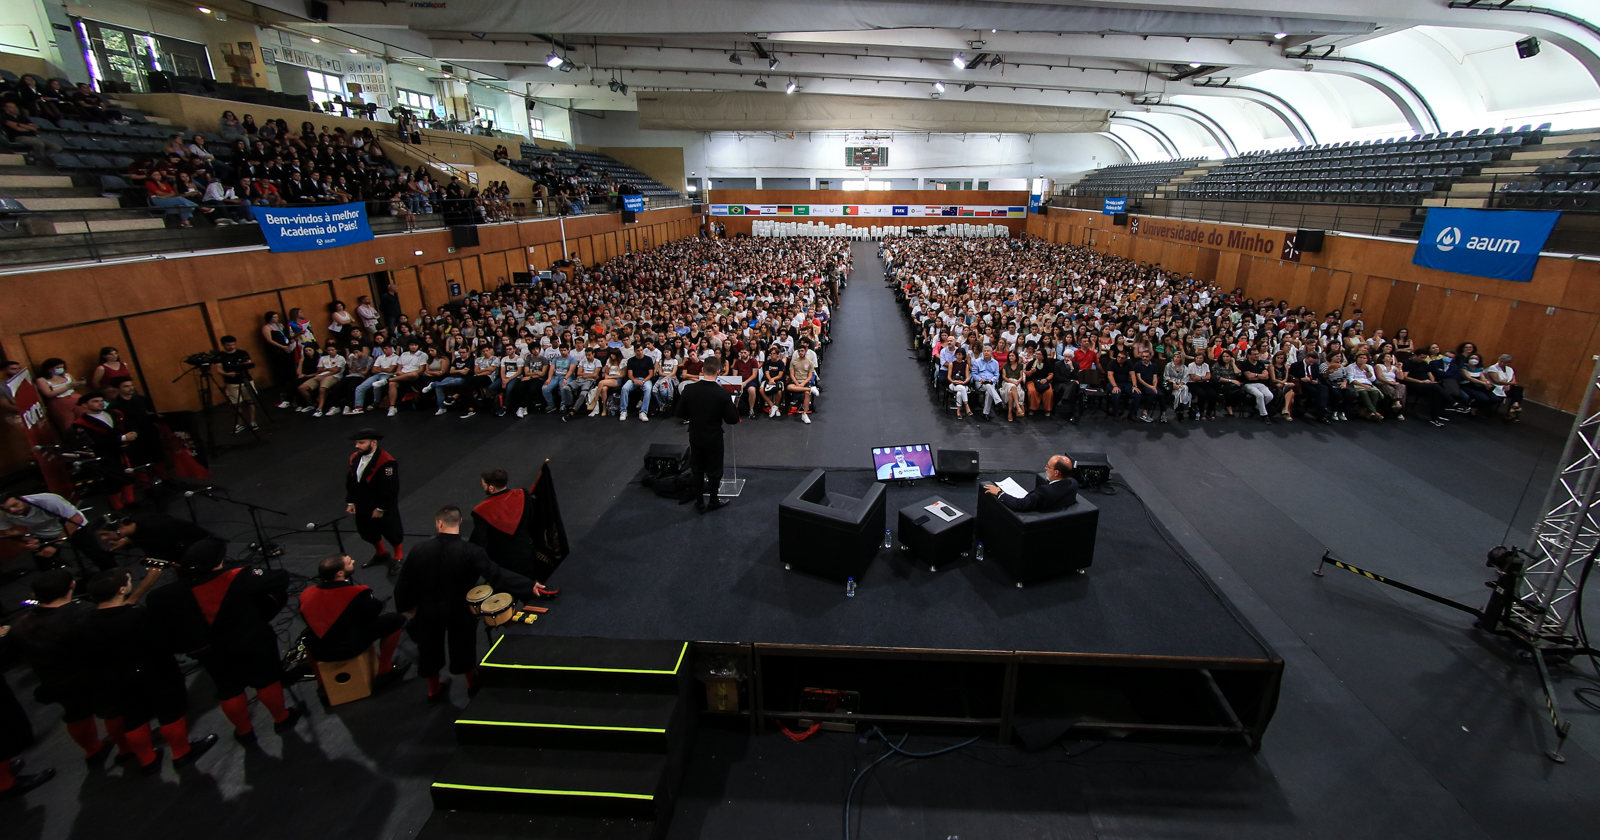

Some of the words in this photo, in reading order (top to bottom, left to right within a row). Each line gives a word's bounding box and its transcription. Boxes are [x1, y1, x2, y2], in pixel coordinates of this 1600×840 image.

[265, 213, 323, 225] Bem-vindos
[325, 212, 331, 222] à
[332, 209, 360, 221] melhor
[280, 224, 326, 237] Academia
[326, 224, 337, 234] do
[338, 220, 358, 232] País!
[1142, 220, 1204, 245] Universidade
[1207, 228, 1223, 246] do
[1227, 229, 1274, 254] Minho
[1466, 236, 1521, 254] aaum
